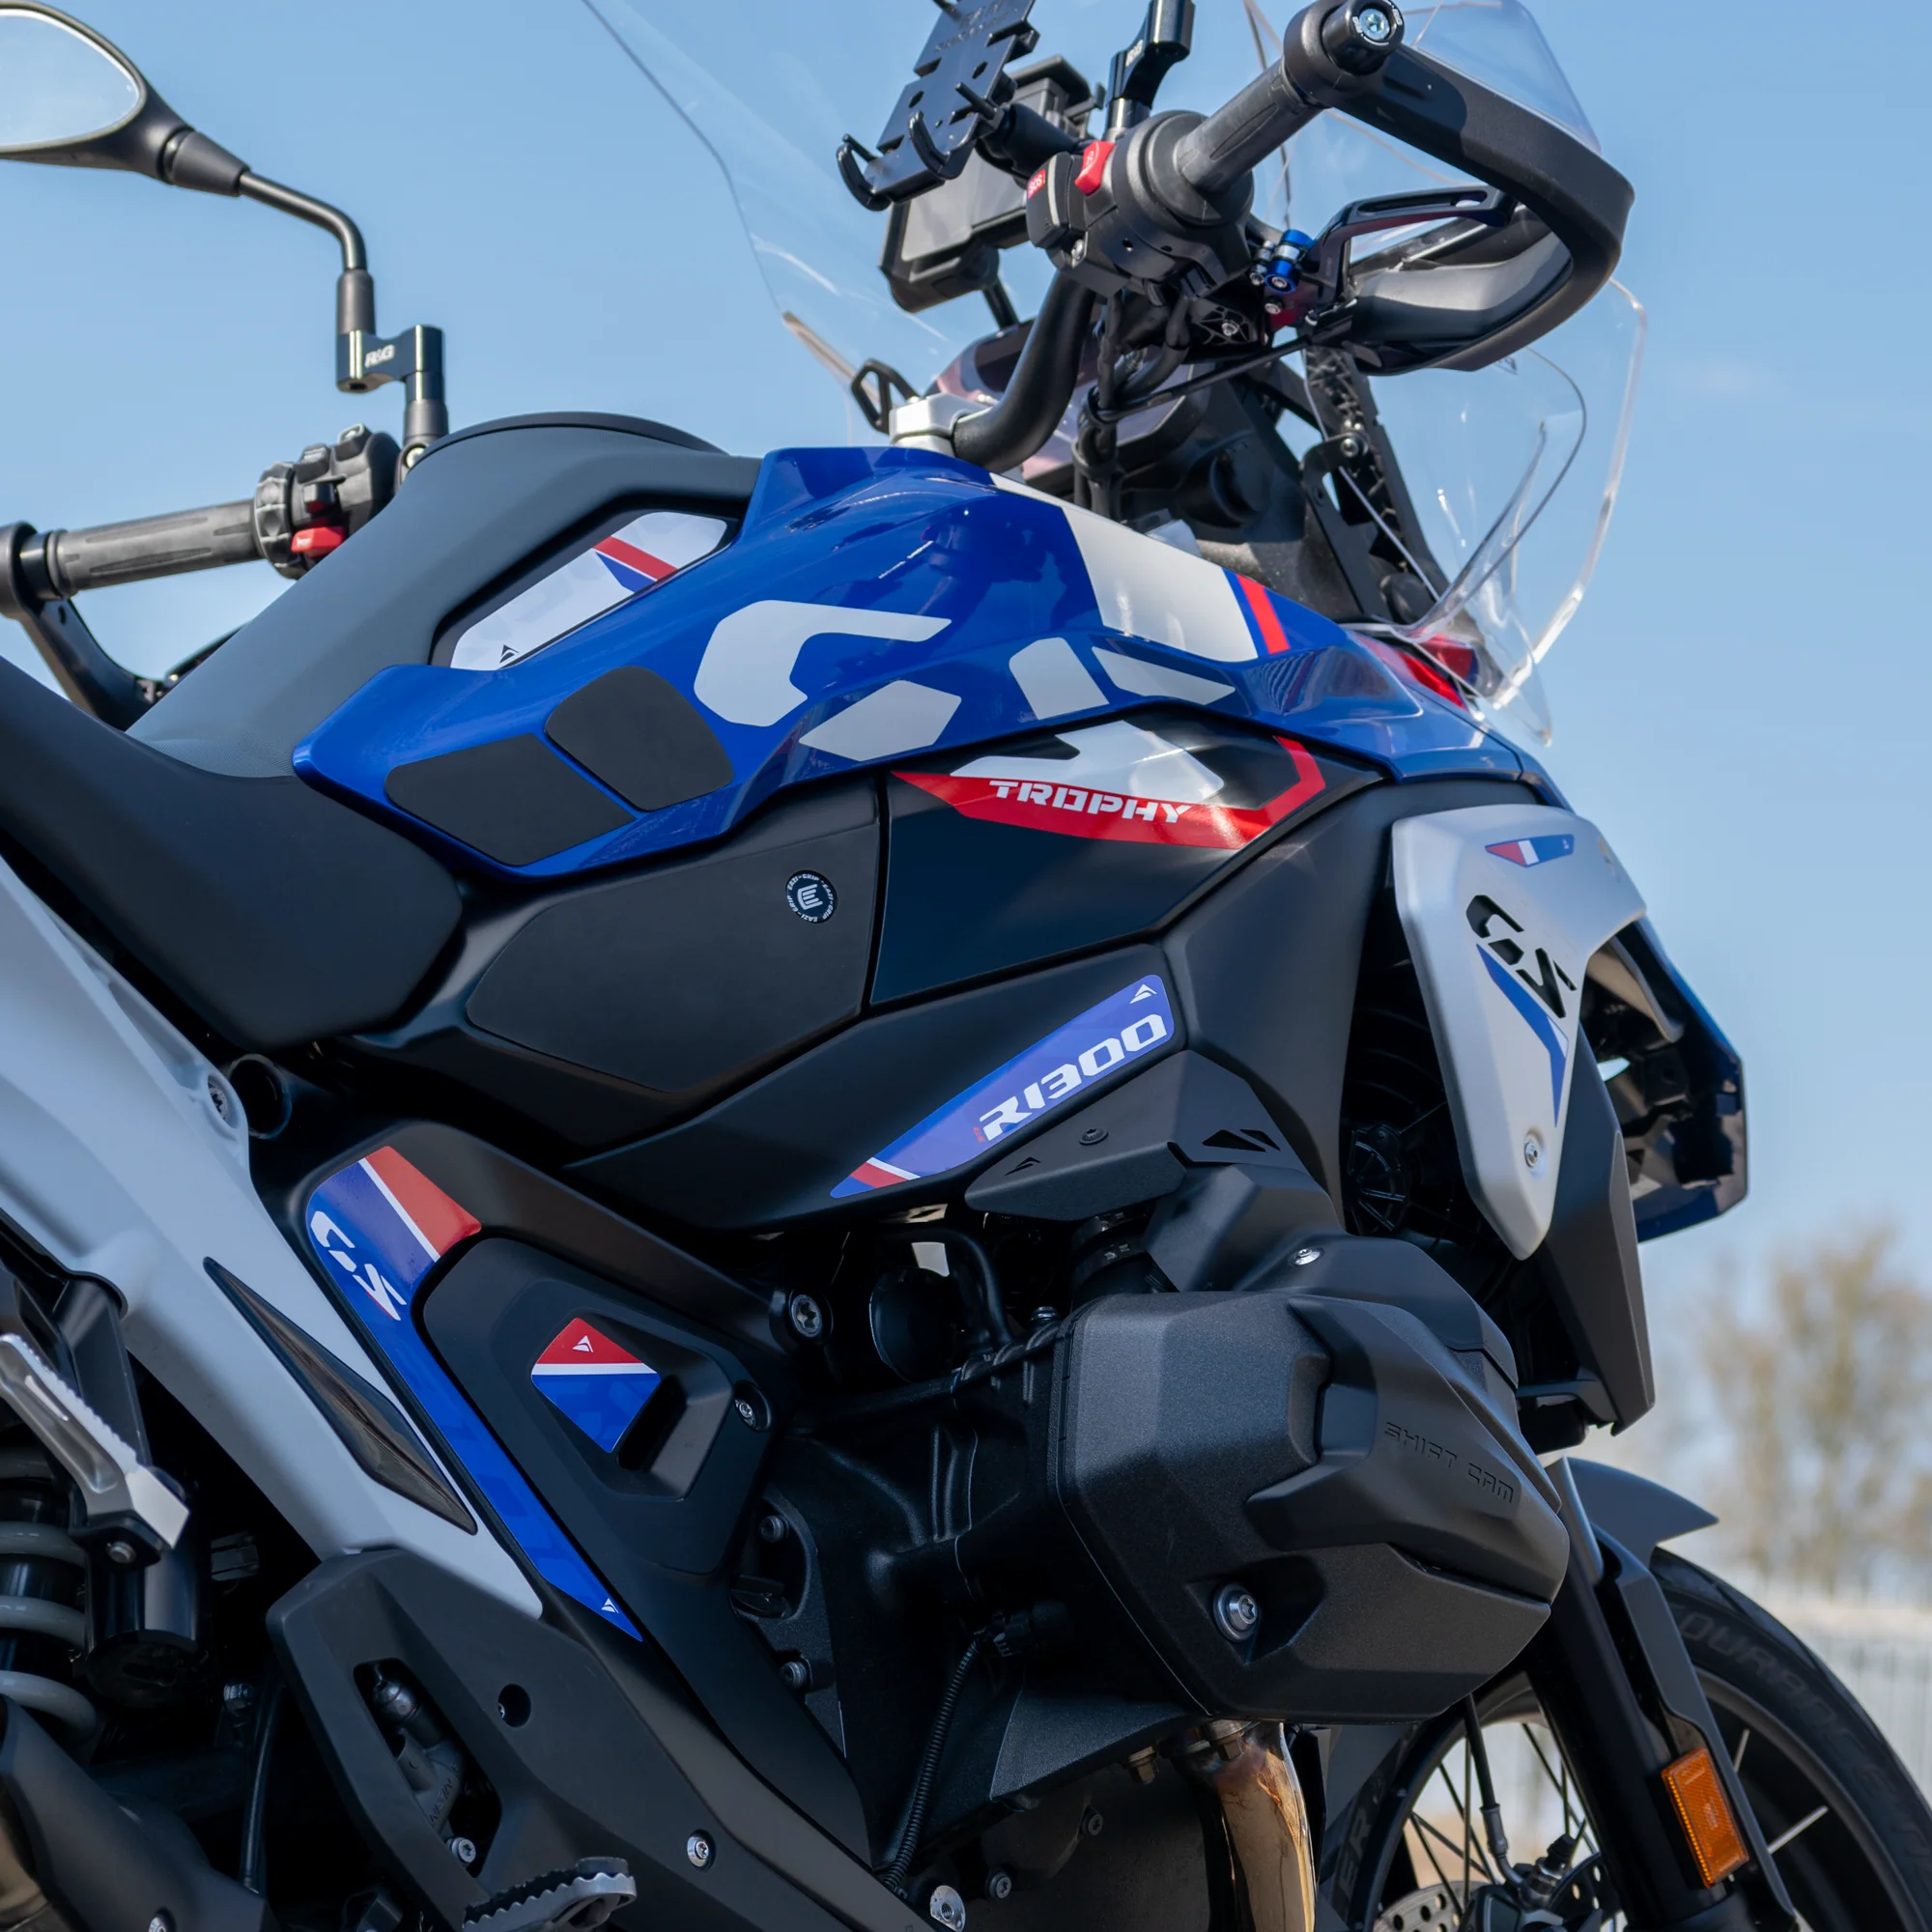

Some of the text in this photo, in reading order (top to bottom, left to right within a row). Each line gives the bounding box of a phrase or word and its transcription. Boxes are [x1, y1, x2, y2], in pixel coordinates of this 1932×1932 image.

[364, 343, 395, 369] R&G
[989, 781, 1191, 823] TROPHY
[1466, 895, 1577, 1018] GS
[980, 1014, 1167, 1141] R1300
[310, 1210, 407, 1321] GS
[1384, 1421, 1514, 1504] SHIFT CAM
